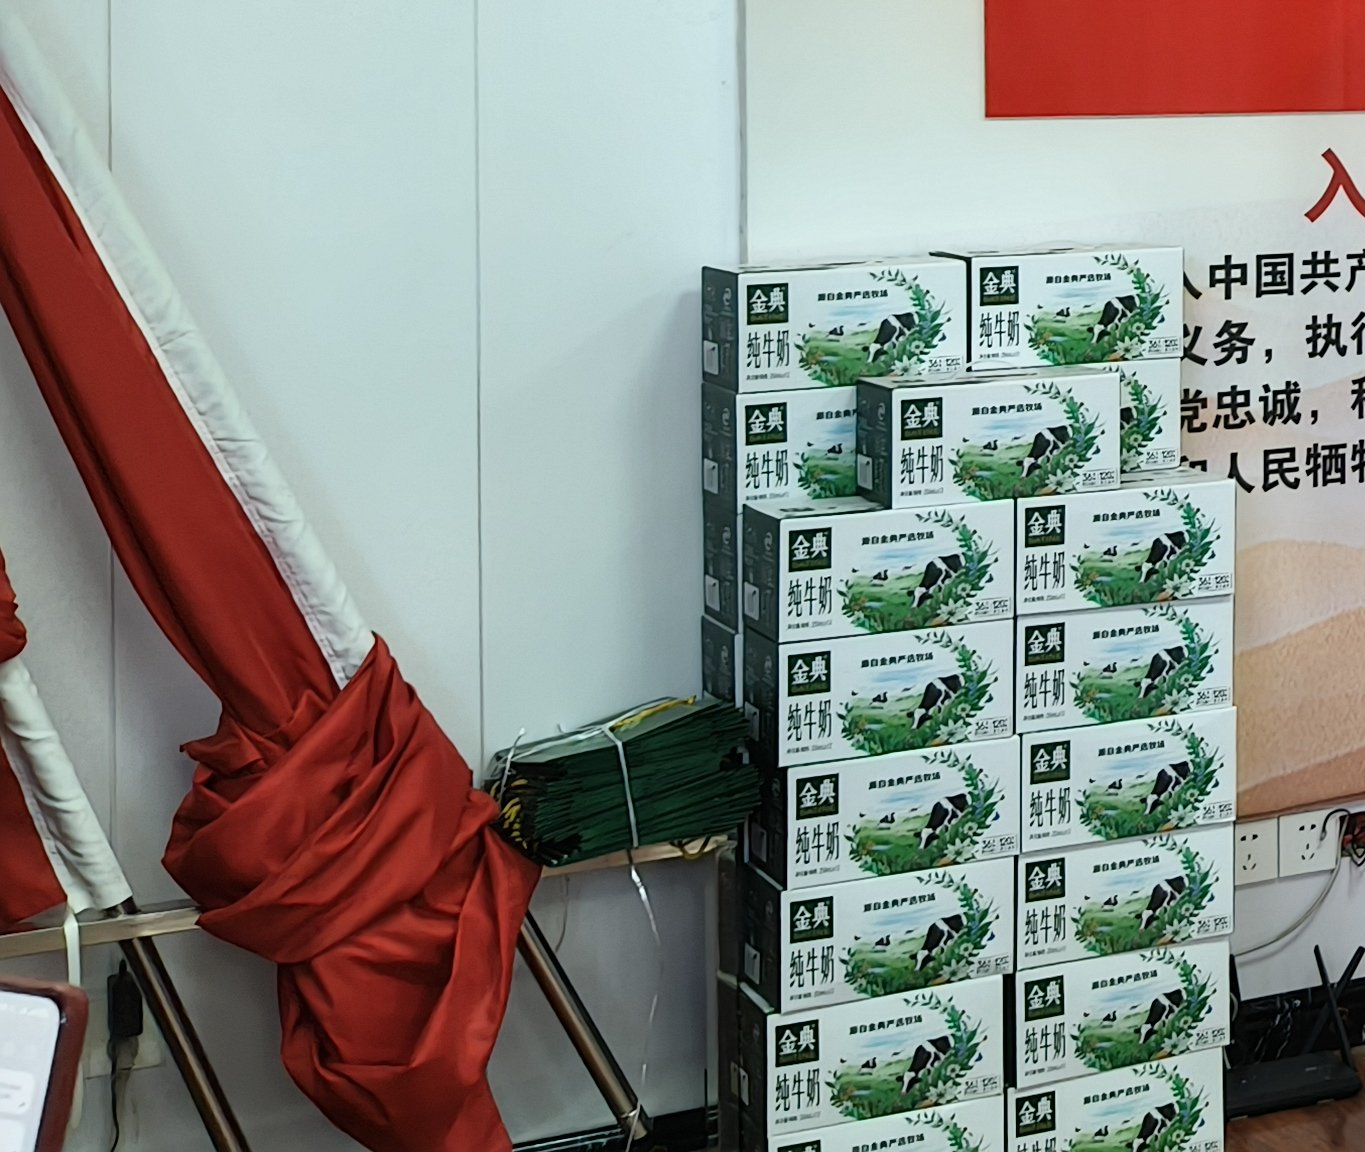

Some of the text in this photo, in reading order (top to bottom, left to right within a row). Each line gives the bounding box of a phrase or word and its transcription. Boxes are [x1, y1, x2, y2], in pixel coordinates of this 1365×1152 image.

[982, 269, 1016, 295] 金典
[749, 286, 785, 313] 金典
[979, 311, 1020, 348] 纯牛奶
[747, 330, 790, 369] 纯牛奶
[748, 406, 784, 434] 金典
[904, 401, 939, 428] 金典
[745, 449, 789, 490] 纯牛奶
[901, 445, 944, 485] 纯牛奶
[1027, 508, 1062, 536] 金典
[791, 531, 828, 560] 金典
[1024, 551, 1066, 591] 纯牛奶
[788, 575, 833, 618] 纯牛奶
[1027, 626, 1062, 654] 金典
[790, 654, 828, 684] 金典
[1024, 669, 1066, 710] 纯牛奶
[787, 699, 832, 742] 纯牛奶
[1033, 743, 1067, 773] 金典
[799, 777, 836, 808] 金典
[1030, 786, 1071, 829] 纯牛奶
[796, 821, 840, 865] 纯牛奶
[1028, 861, 1062, 891] 金典
[793, 900, 830, 931] 金典
[1025, 904, 1066, 946] 纯牛奶
[790, 944, 835, 989] 纯牛奶
[1027, 979, 1061, 1010] 金典
[778, 1023, 816, 1055] 金典
[1025, 1021, 1066, 1065] 纯牛奶
[775, 1067, 821, 1113] 纯牛奶
[1017, 1094, 1053, 1126] 金典
